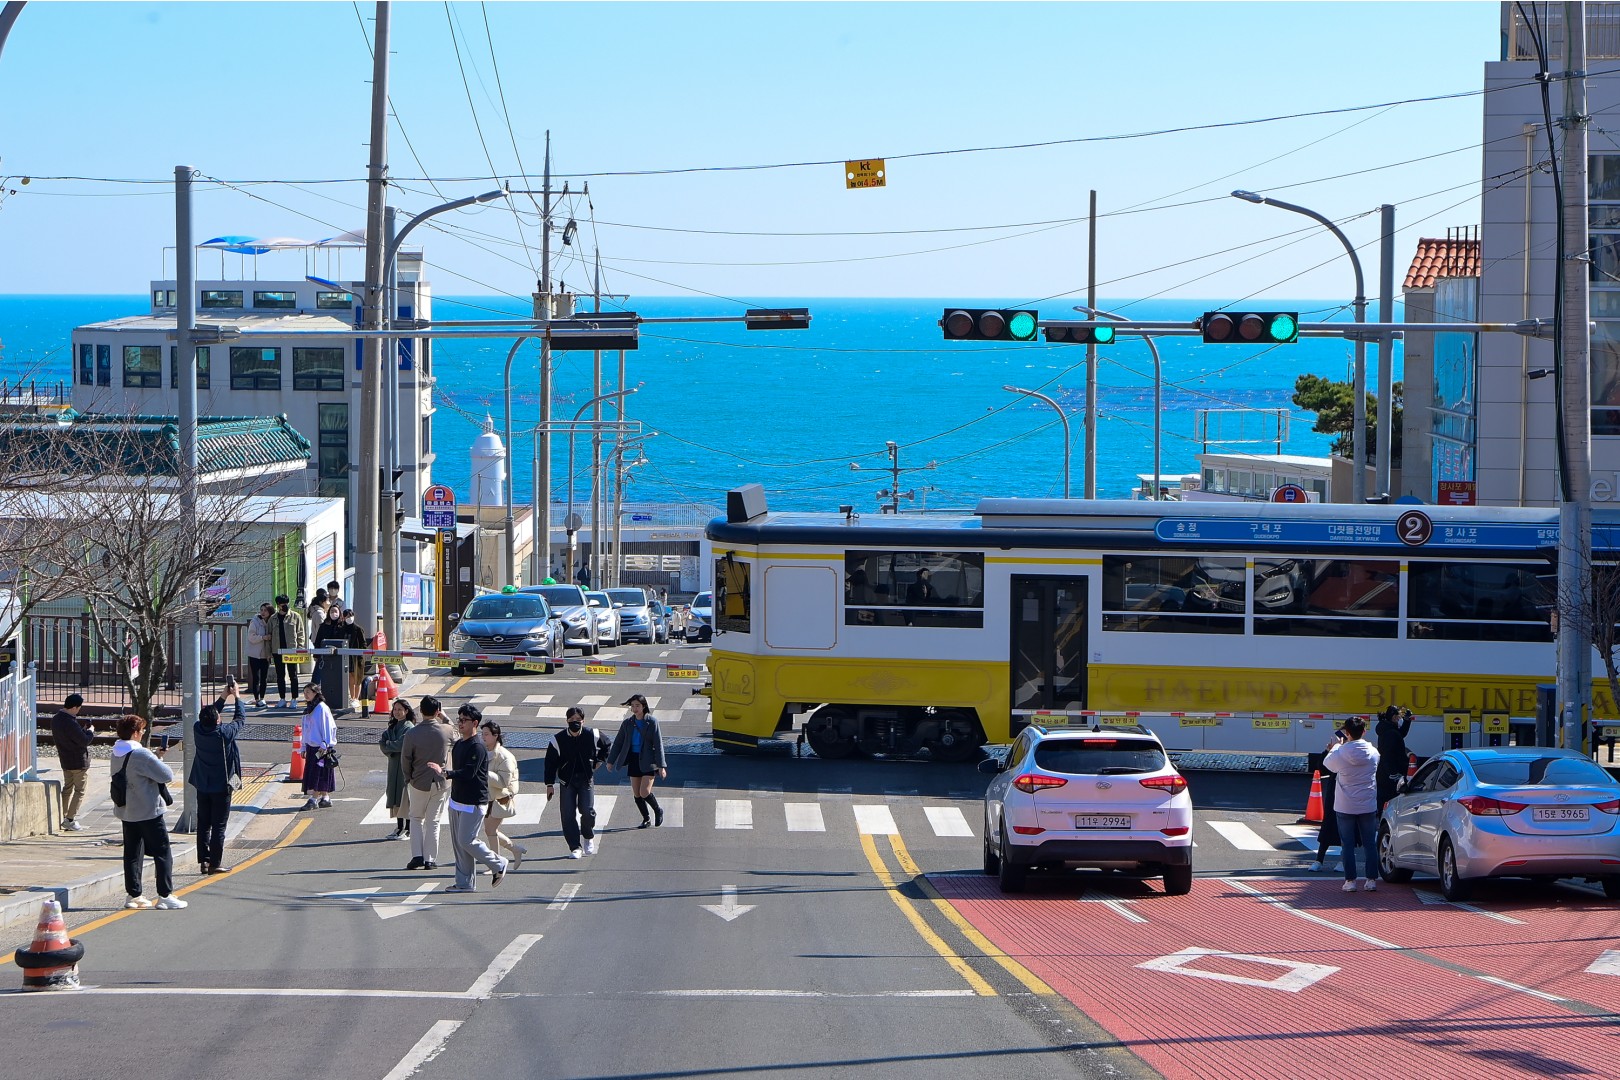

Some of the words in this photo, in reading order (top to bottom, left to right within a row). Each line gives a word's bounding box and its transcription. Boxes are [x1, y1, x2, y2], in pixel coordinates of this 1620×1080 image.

[860, 161, 871, 171] kt
[1176, 522, 1197, 532] 송정
[1250, 523, 1282, 533] 구덕포
[1328, 525, 1381, 535] 다릿돌전망대
[1405, 516, 1423, 540] 2
[1444, 527, 1477, 537] 청사포
[1144, 678, 1344, 708] HAEUNDAE
[1365, 684, 1537, 713] BLUELINE
[1560, 810, 1585, 818] 3965
[1081, 817, 1098, 826] 11우
[1103, 817, 1126, 826] 2994
